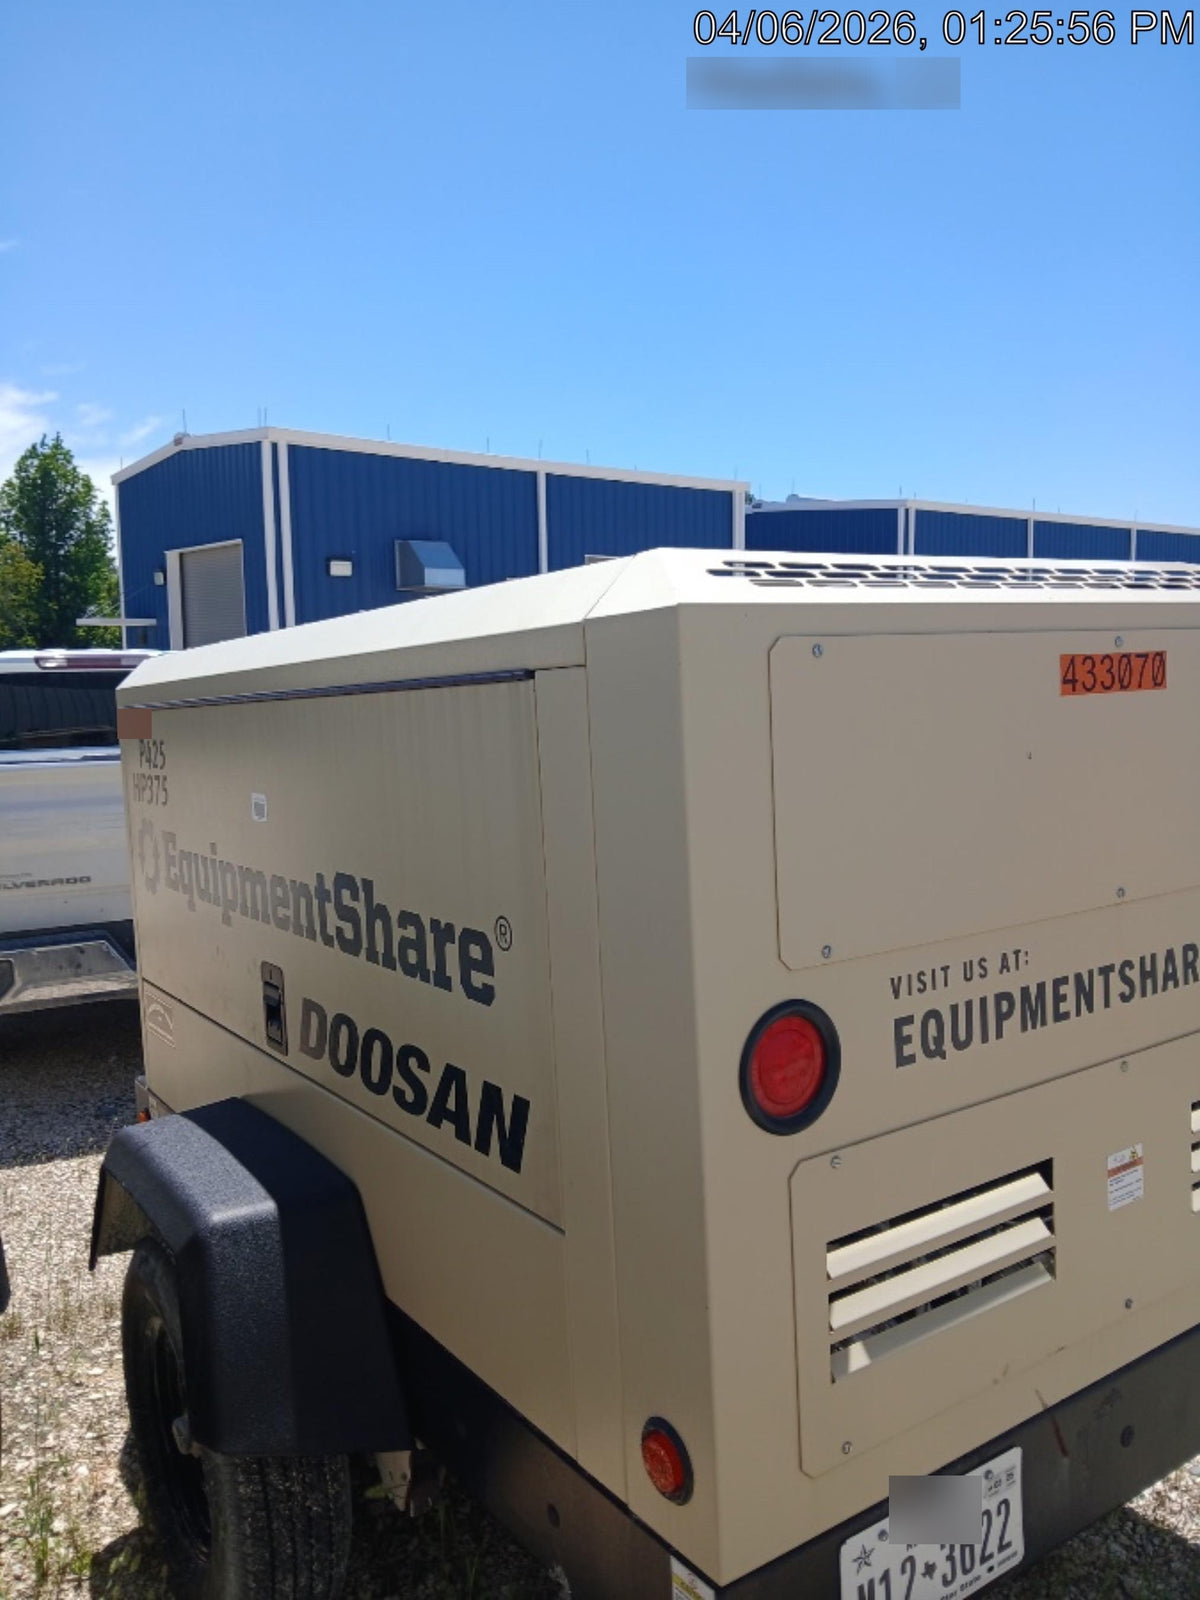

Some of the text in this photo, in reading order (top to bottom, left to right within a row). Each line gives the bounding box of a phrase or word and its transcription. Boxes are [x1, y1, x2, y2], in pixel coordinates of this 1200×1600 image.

[1062, 652, 1166, 692] 433070
[139, 739, 166, 769] P425
[0, 876, 91, 891] LVERADO
[890, 949, 1029, 1000] VISIT US AT:
[893, 943, 1200, 1069] EQUIPMENTSHAR
[300, 998, 530, 1174] DOOSAN
